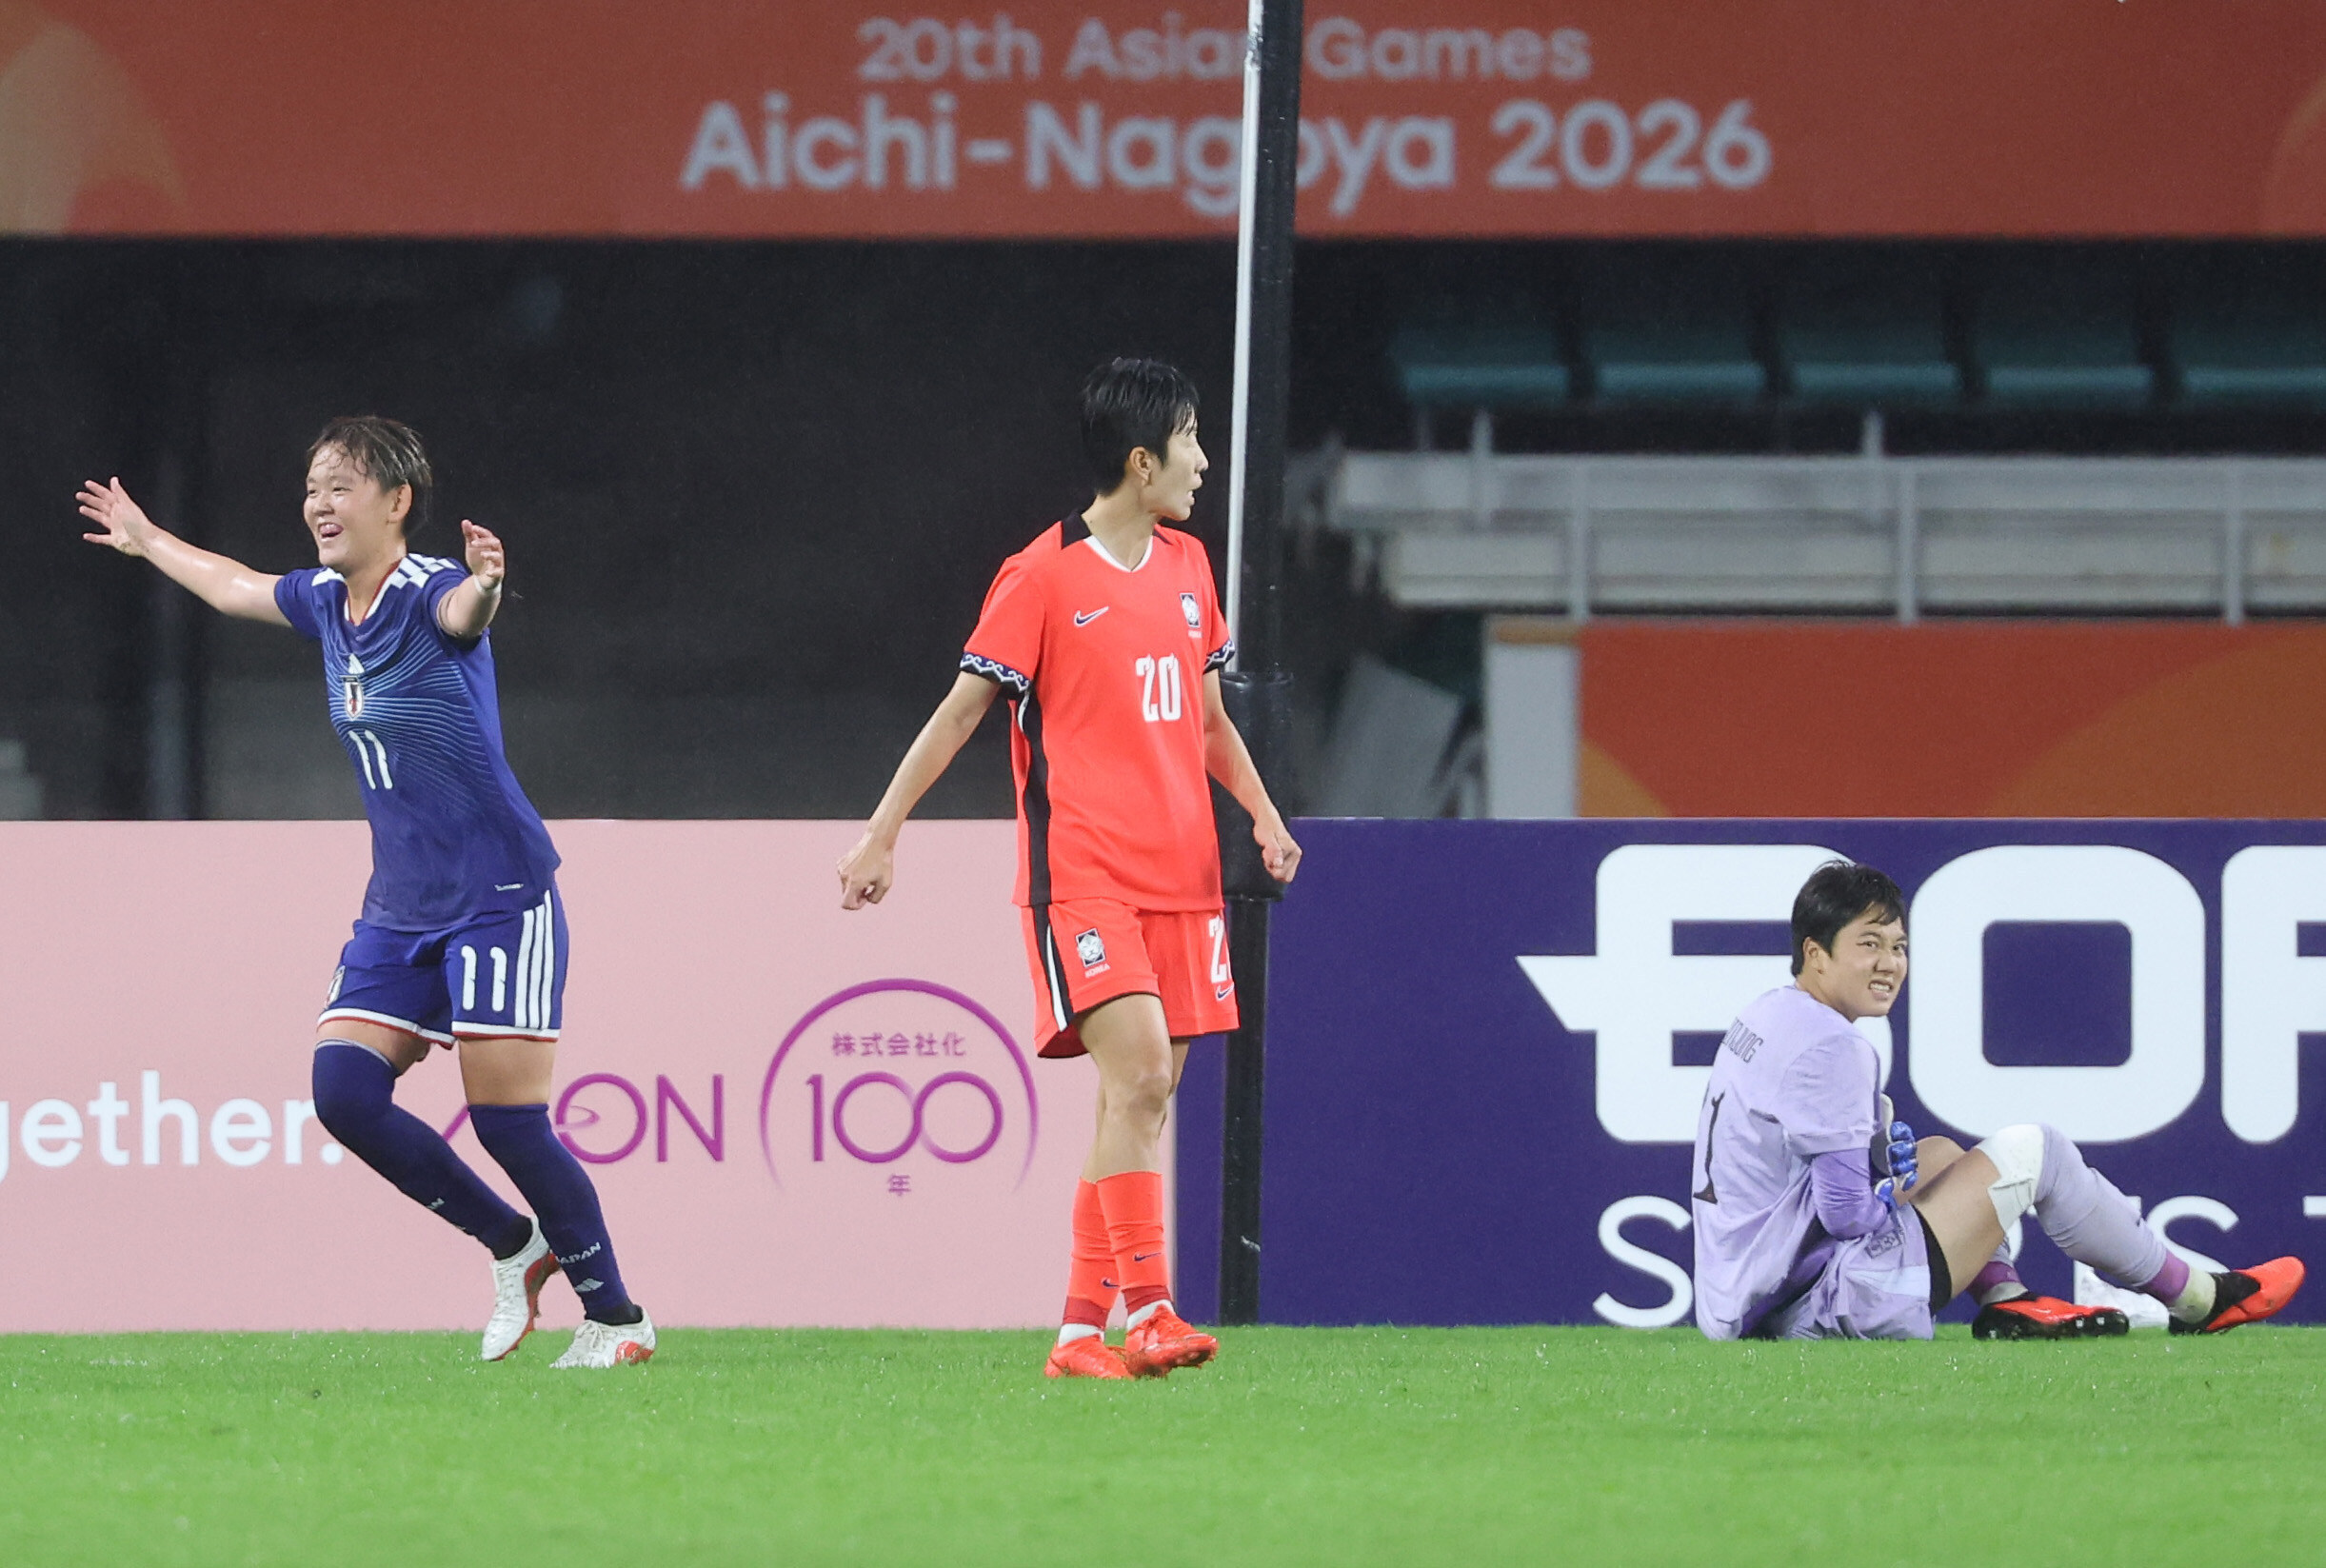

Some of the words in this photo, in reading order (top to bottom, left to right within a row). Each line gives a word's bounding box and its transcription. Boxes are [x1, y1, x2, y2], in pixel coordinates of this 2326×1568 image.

[859, 14, 1041, 81] 20th
[1064, 10, 1249, 81] Asia
[1304, 15, 1593, 81] Games
[1488, 97, 1772, 190] 2026
[1135, 653, 1183, 723] 20
[348, 729, 393, 790] 11
[461, 944, 507, 1012] 11
[1208, 915, 1232, 983] 2
[832, 1032, 966, 1057] 株式会社化
[0, 1069, 344, 1185] ether.
[805, 1070, 1004, 1164] 100
[887, 1174, 912, 1197] 年
